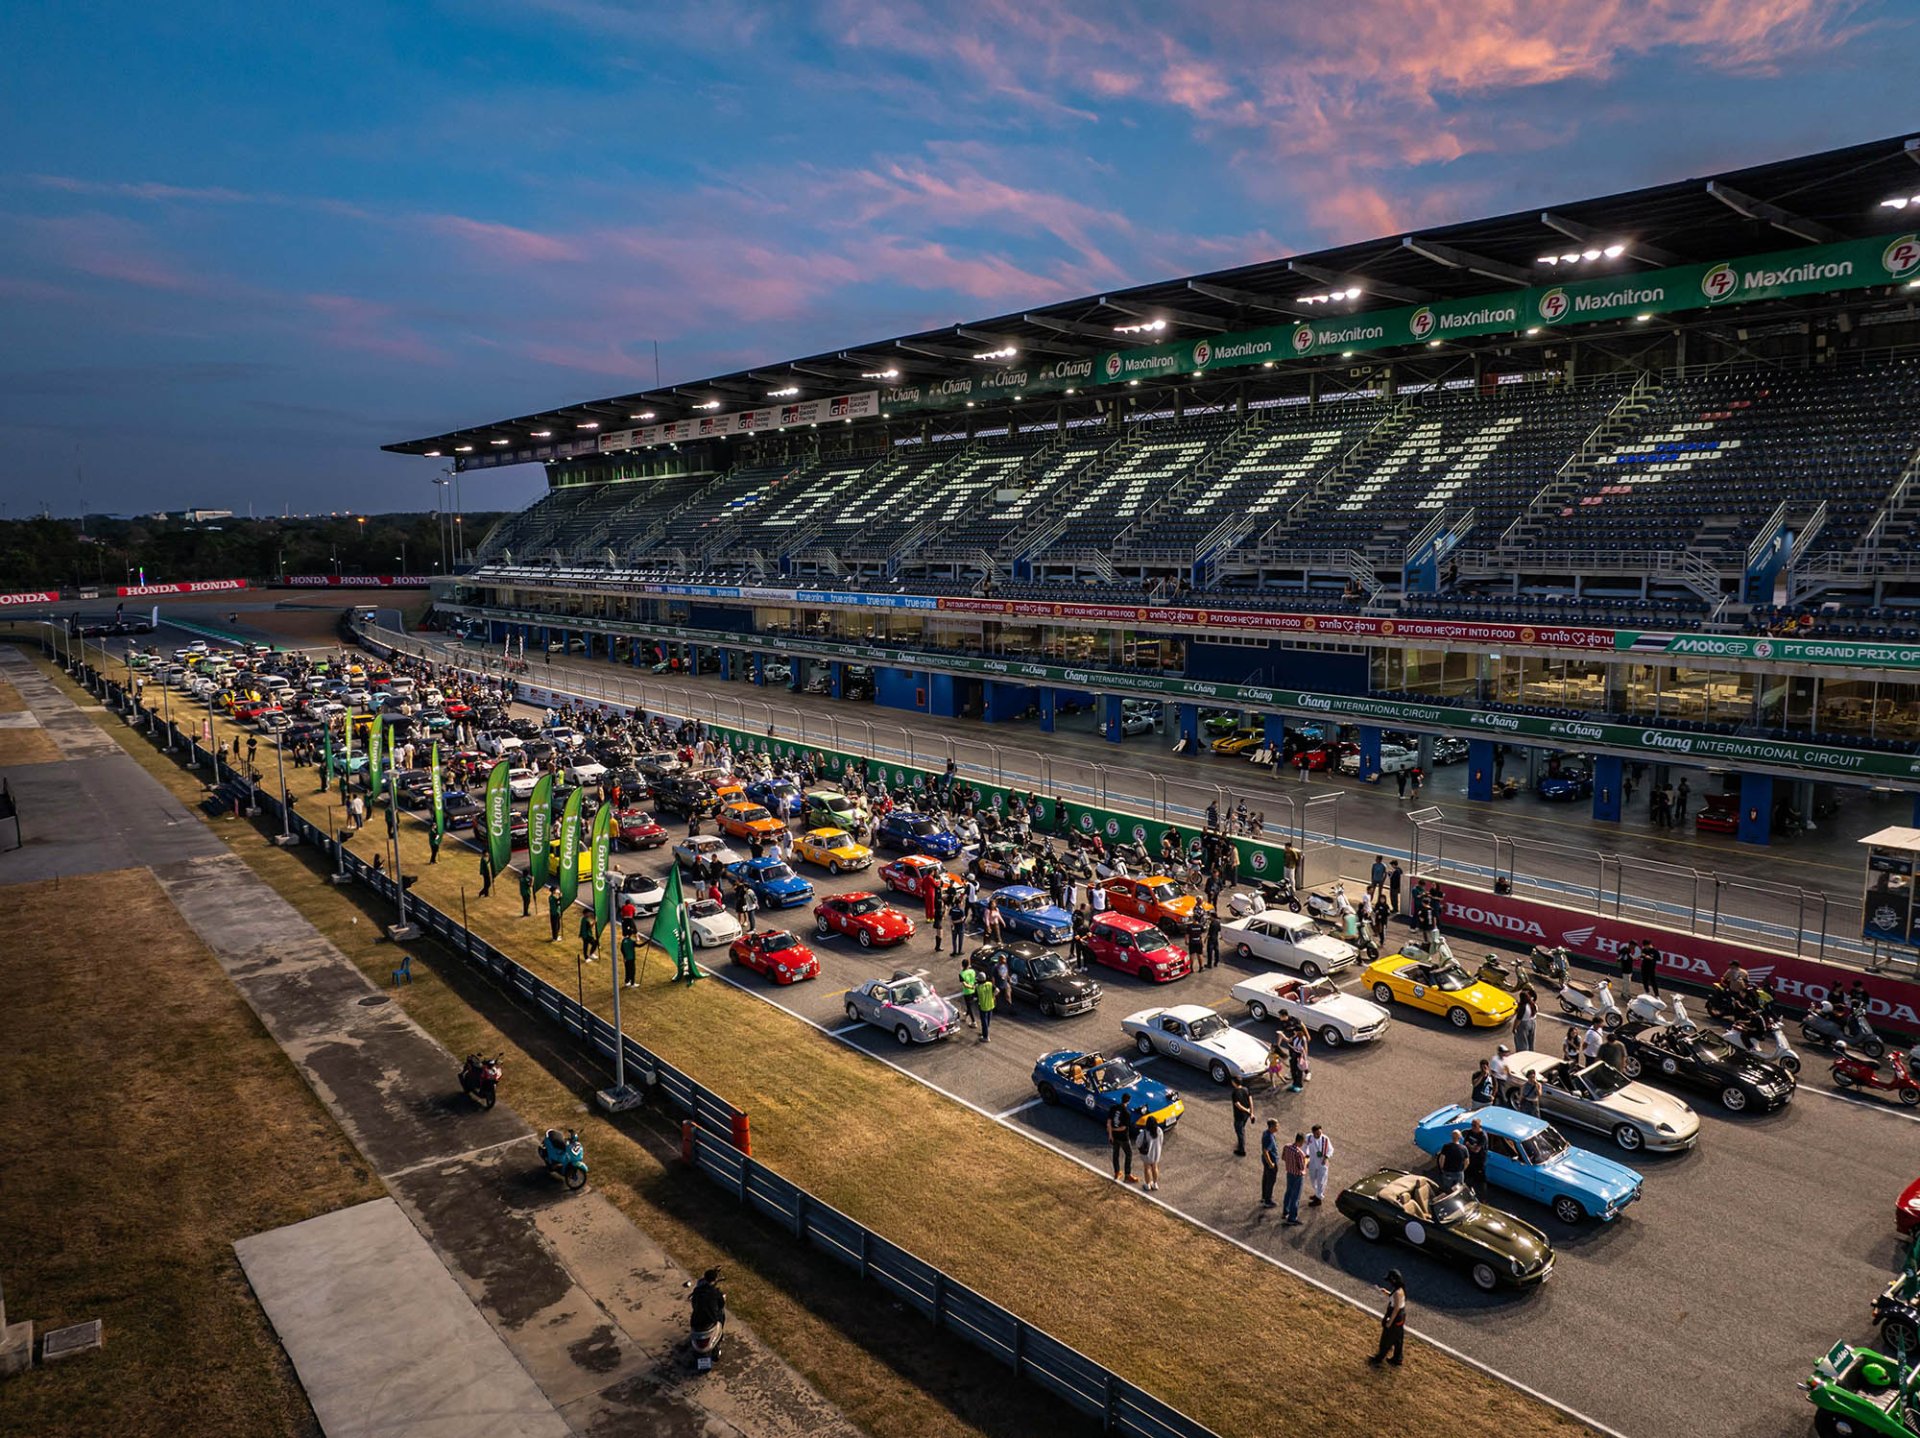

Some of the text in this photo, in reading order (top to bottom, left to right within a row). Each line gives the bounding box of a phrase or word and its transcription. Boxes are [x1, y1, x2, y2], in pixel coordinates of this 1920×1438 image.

[1743, 261, 1853, 289] Maxnitron
[1575, 287, 1664, 312] Maxnitron
[1439, 308, 1515, 329] Maxnitron
[1318, 326, 1383, 345] Maxnitron
[1215, 341, 1272, 359] Maxnitron
[1055, 360, 1092, 379] Chang
[1125, 356, 1174, 371] Maxnitron
[995, 370, 1028, 387] Chang
[190, 580, 239, 591] HONDA
[290, 576, 329, 584] HONDA
[340, 576, 381, 585] HONDA
[392, 576, 428, 584] HOND
[126, 584, 181, 596] HONDA
[1264, 618, 1280, 626] INTO
[1281, 618, 1300, 627] FOOD
[1398, 625, 1415, 634] PUT
[1415, 626, 1432, 635] OUR
[1468, 629, 1489, 638] INTO
[1491, 629, 1515, 639] FOOD
[1784, 645, 1920, 662] PT GRAND PRIX OF
[990, 659, 1008, 672] Chang
[1028, 663, 1047, 677] Chang
[1064, 669, 1163, 689] Chang INTERNATIONAL CIRCUIT
[1193, 682, 1216, 696] Chang
[1247, 687, 1273, 701] Chang
[1298, 694, 1441, 720] Chang INTERNATIONAL CIRCUIT
[1485, 713, 1519, 730] Chang
[1566, 722, 1603, 740] Chang
[1641, 730, 1865, 767] Chang INTERNATIONAL CIRCUIT
[493, 795, 505, 837] Chang
[531, 812, 545, 854] Chang
[562, 824, 576, 870] Chang
[595, 843, 606, 892] Chang
[1445, 901, 1547, 938] HONDA
[1595, 936, 1716, 977] HODA
[1775, 976, 1920, 1024] HODA
